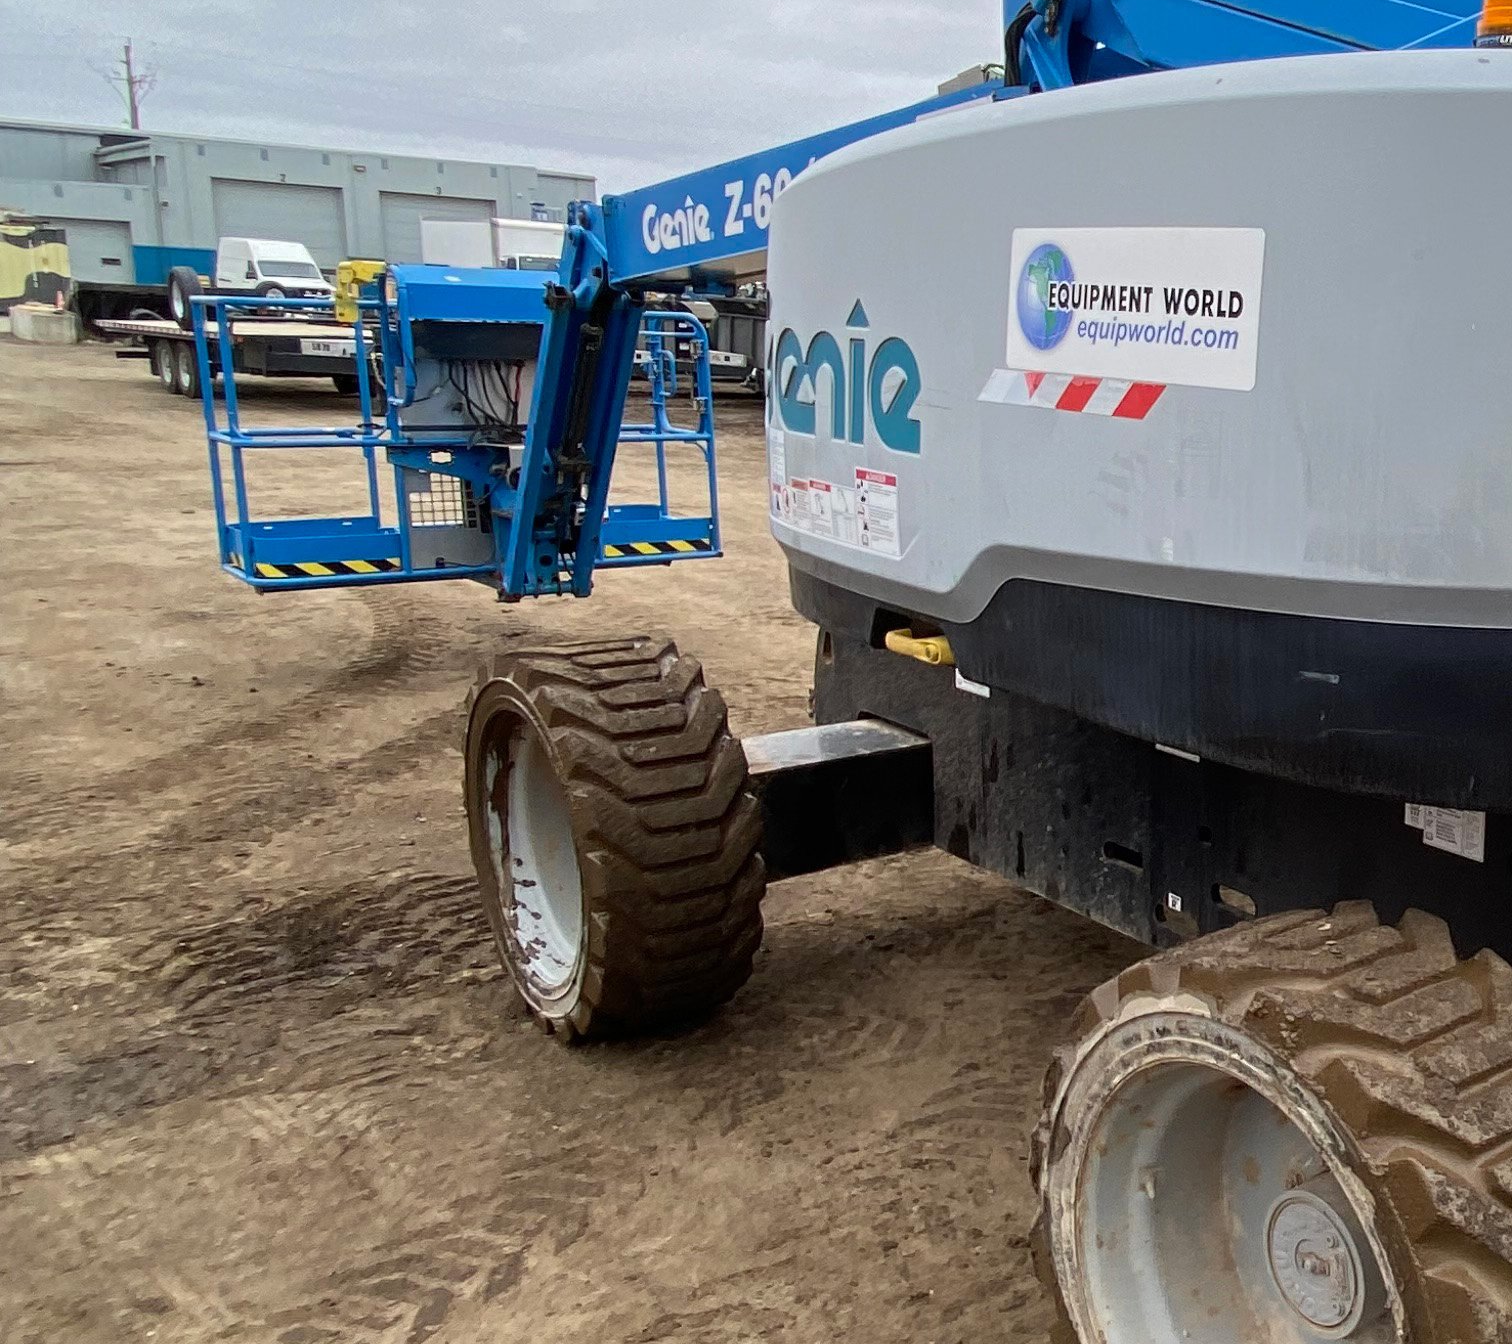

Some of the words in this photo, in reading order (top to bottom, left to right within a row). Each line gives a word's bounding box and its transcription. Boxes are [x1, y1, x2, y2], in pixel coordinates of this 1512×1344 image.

[642, 195, 714, 254] Genie
[1049, 283, 1153, 313] EQUIPMENT
[1164, 287, 1244, 318] WORLD
[1077, 317, 1239, 349] equipworld.com
[767, 298, 922, 456] enie
